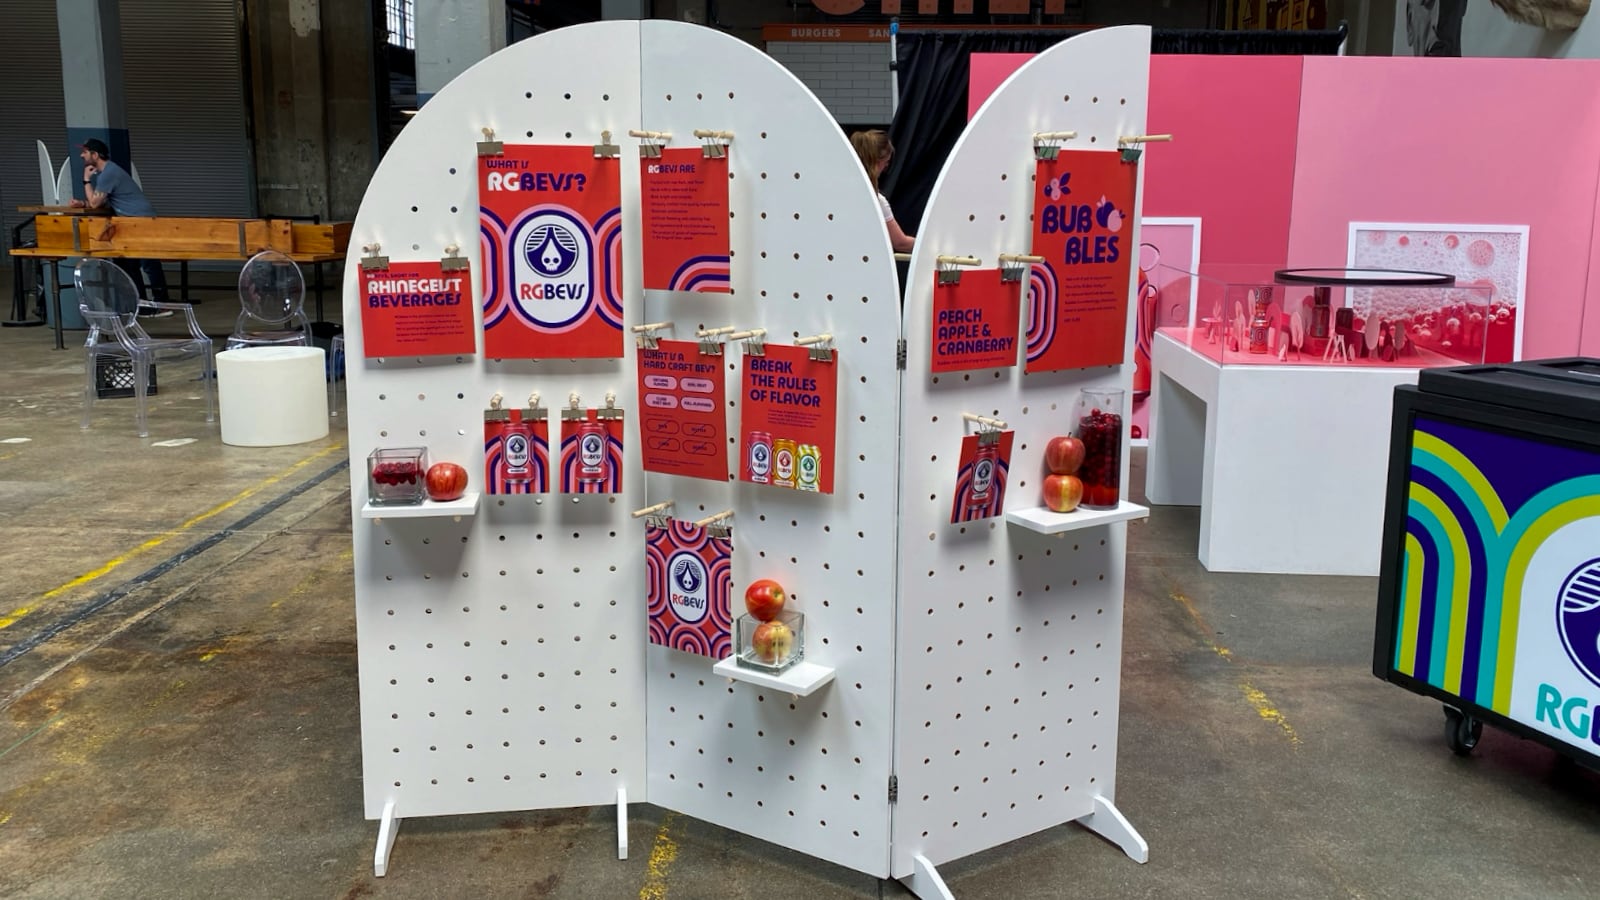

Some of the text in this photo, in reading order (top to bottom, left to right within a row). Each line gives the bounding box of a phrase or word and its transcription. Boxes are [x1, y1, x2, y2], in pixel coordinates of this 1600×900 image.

[791, 28, 841, 38] BURGERS
[486, 160, 529, 169] WHAT IS
[648, 165, 695, 173] RGBEVS ARE
[487, 172, 586, 192] RGBEVS?
[1042, 205, 1092, 233] BUB
[1065, 236, 1119, 265] BLES
[368, 279, 462, 294] RHINEGEIST
[521, 283, 584, 300] RGBEVS
[369, 293, 461, 308] BEVERAGES
[939, 309, 982, 324] PEACH
[939, 324, 991, 340] APPLE &
[938, 337, 1013, 355] CRANBERRY
[643, 352, 668, 360] WHAT
[644, 361, 716, 373] HARD CRAFT BEV?
[751, 359, 793, 374] BREAK
[751, 374, 817, 391] THE RULES
[750, 389, 821, 407] OF FLAVOR
[672, 593, 704, 610] RGBEVS
